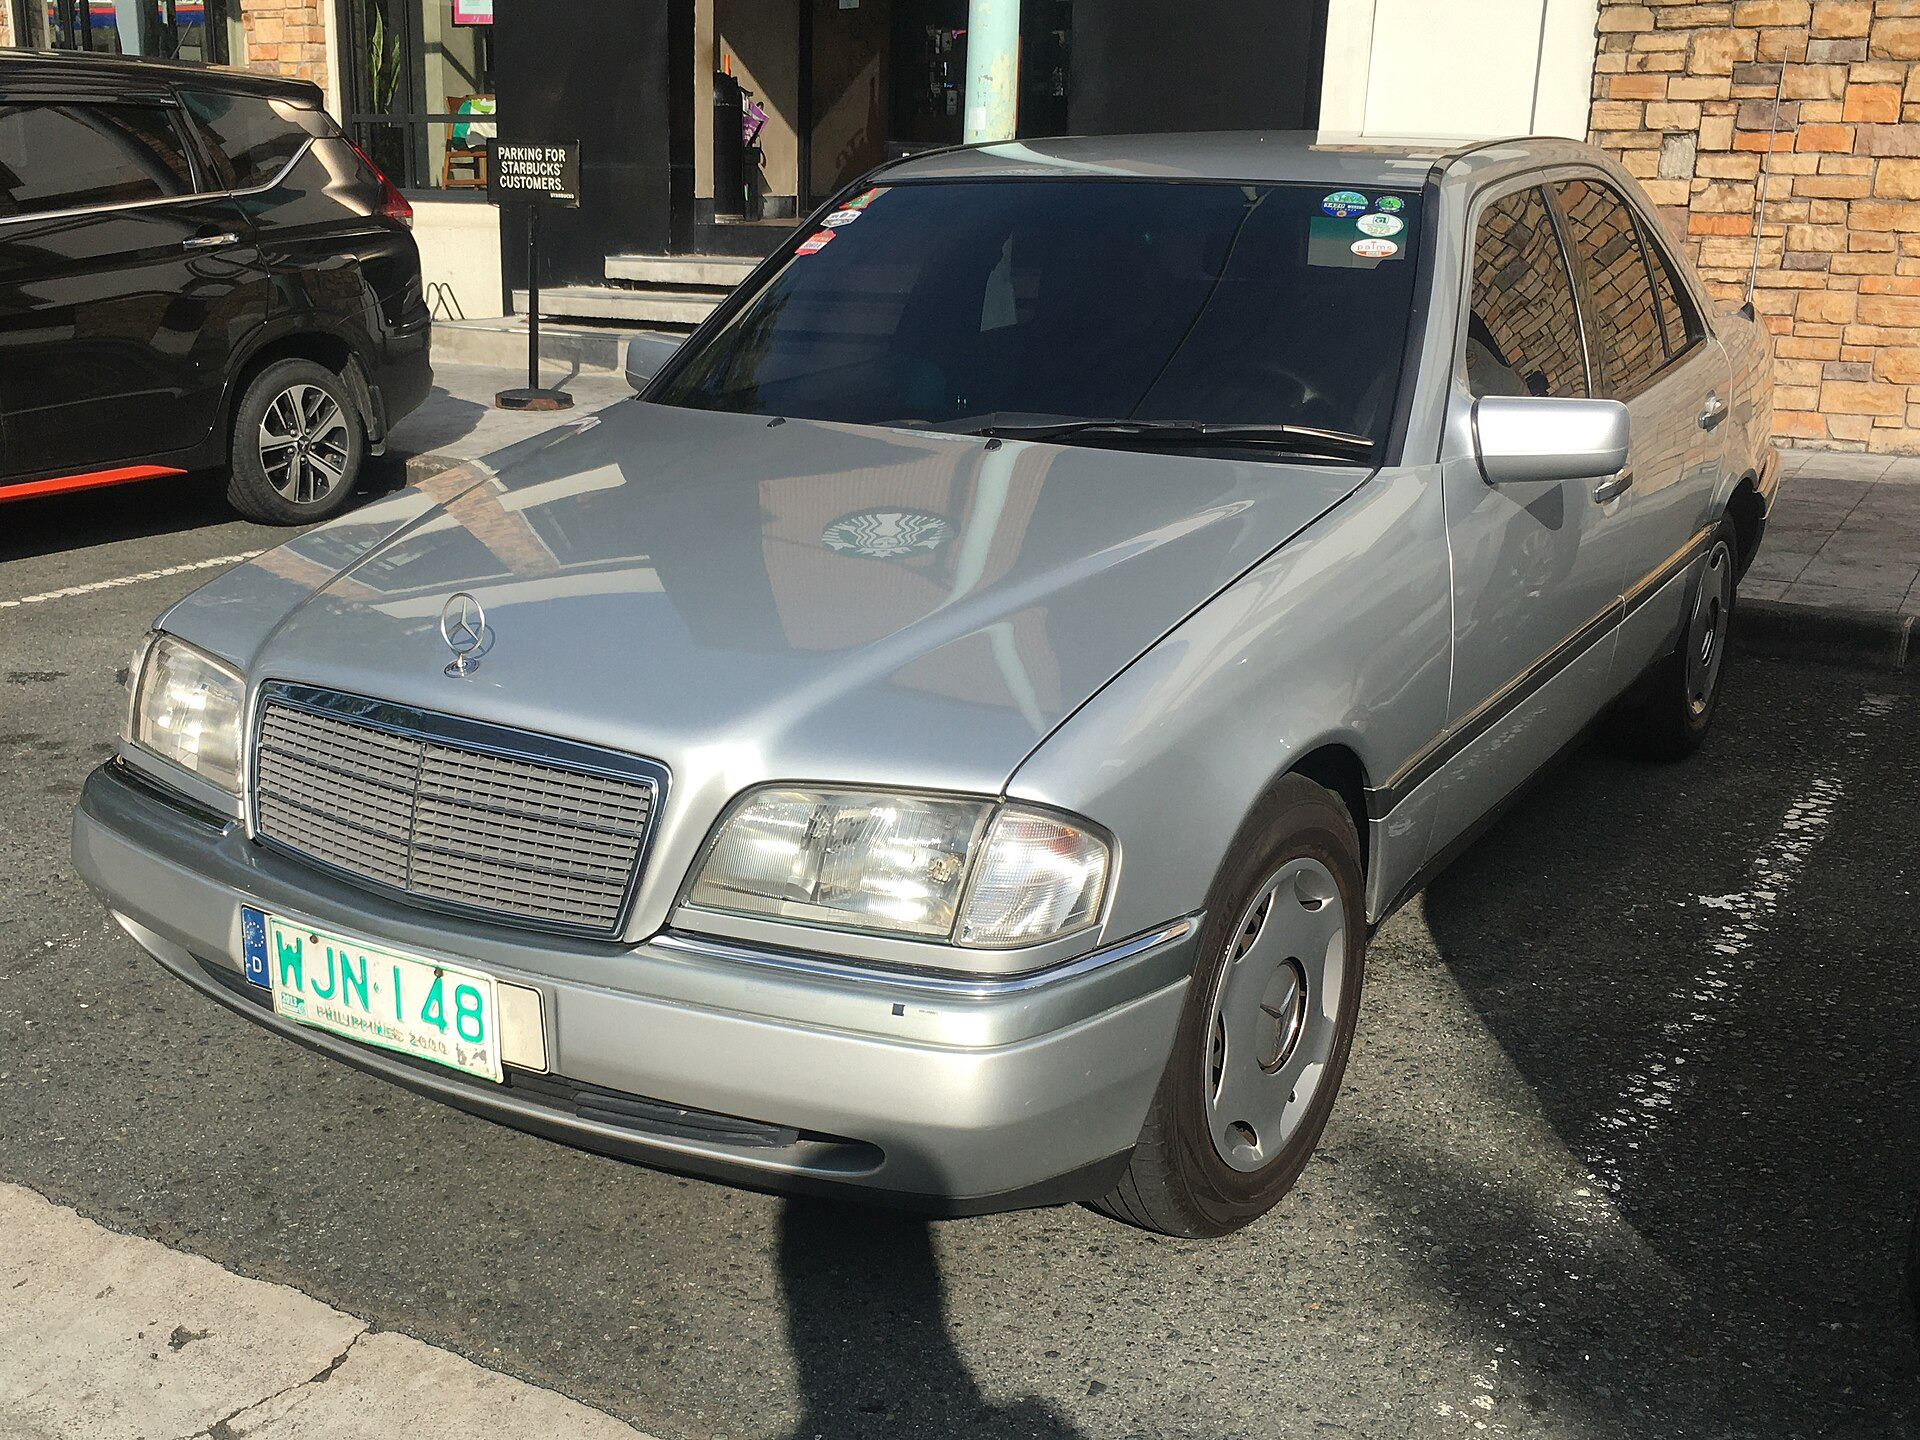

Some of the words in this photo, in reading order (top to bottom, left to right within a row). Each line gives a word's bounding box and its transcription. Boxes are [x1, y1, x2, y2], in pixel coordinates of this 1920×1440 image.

[498, 146, 543, 161] PARKING
[545, 148, 566, 162] FOR
[499, 175, 565, 191] CUSTOMERS.
[252, 956, 262, 973] D
[276, 930, 369, 1012] WJN
[393, 964, 485, 1044] 148
[281, 992, 298, 1006] 2013
